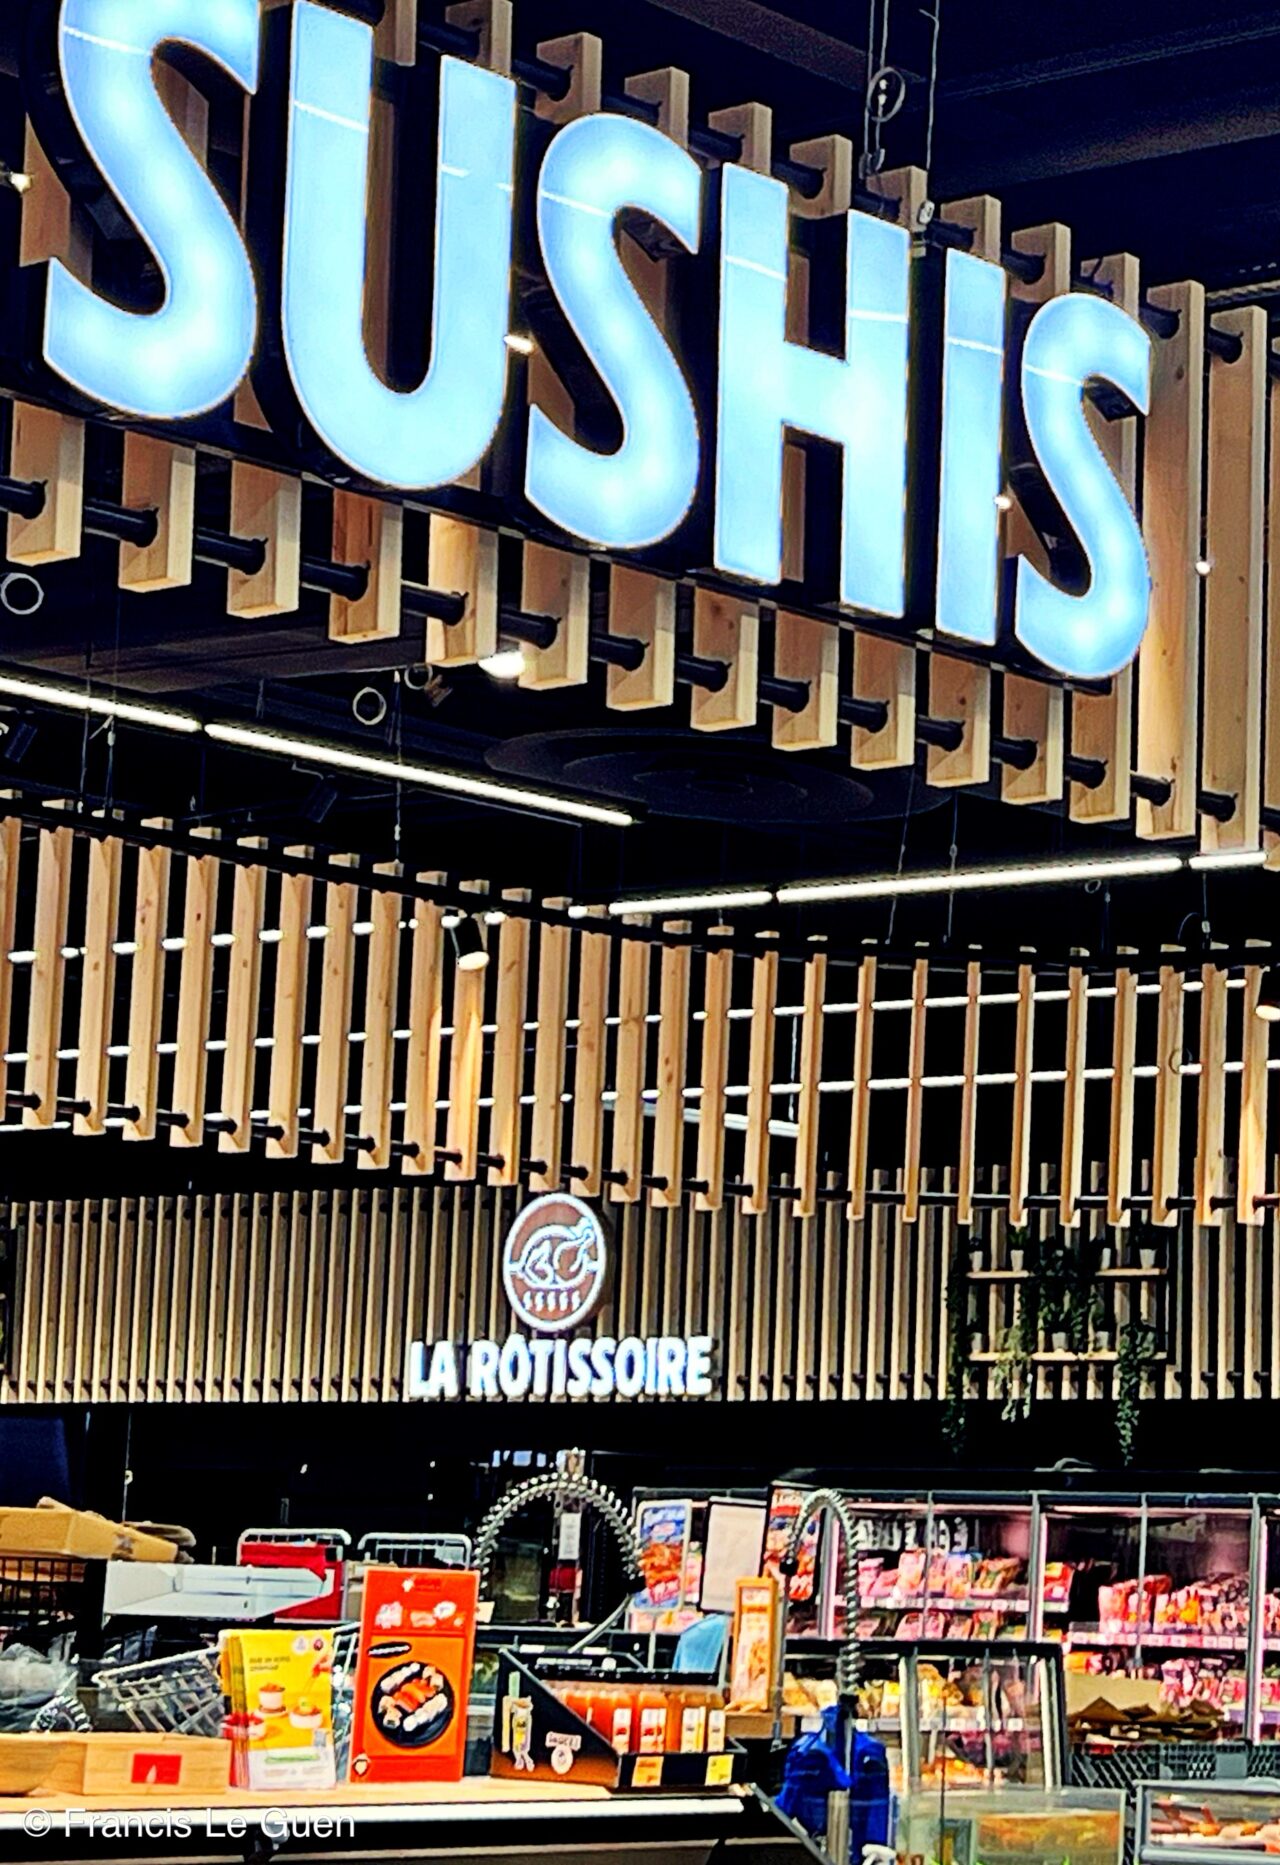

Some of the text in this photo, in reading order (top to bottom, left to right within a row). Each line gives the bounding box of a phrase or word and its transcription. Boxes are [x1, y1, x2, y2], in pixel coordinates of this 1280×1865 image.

[42, 0, 1151, 679] SUSHIS
[408, 1333, 713, 1397] LA RÔTISSOIRE
